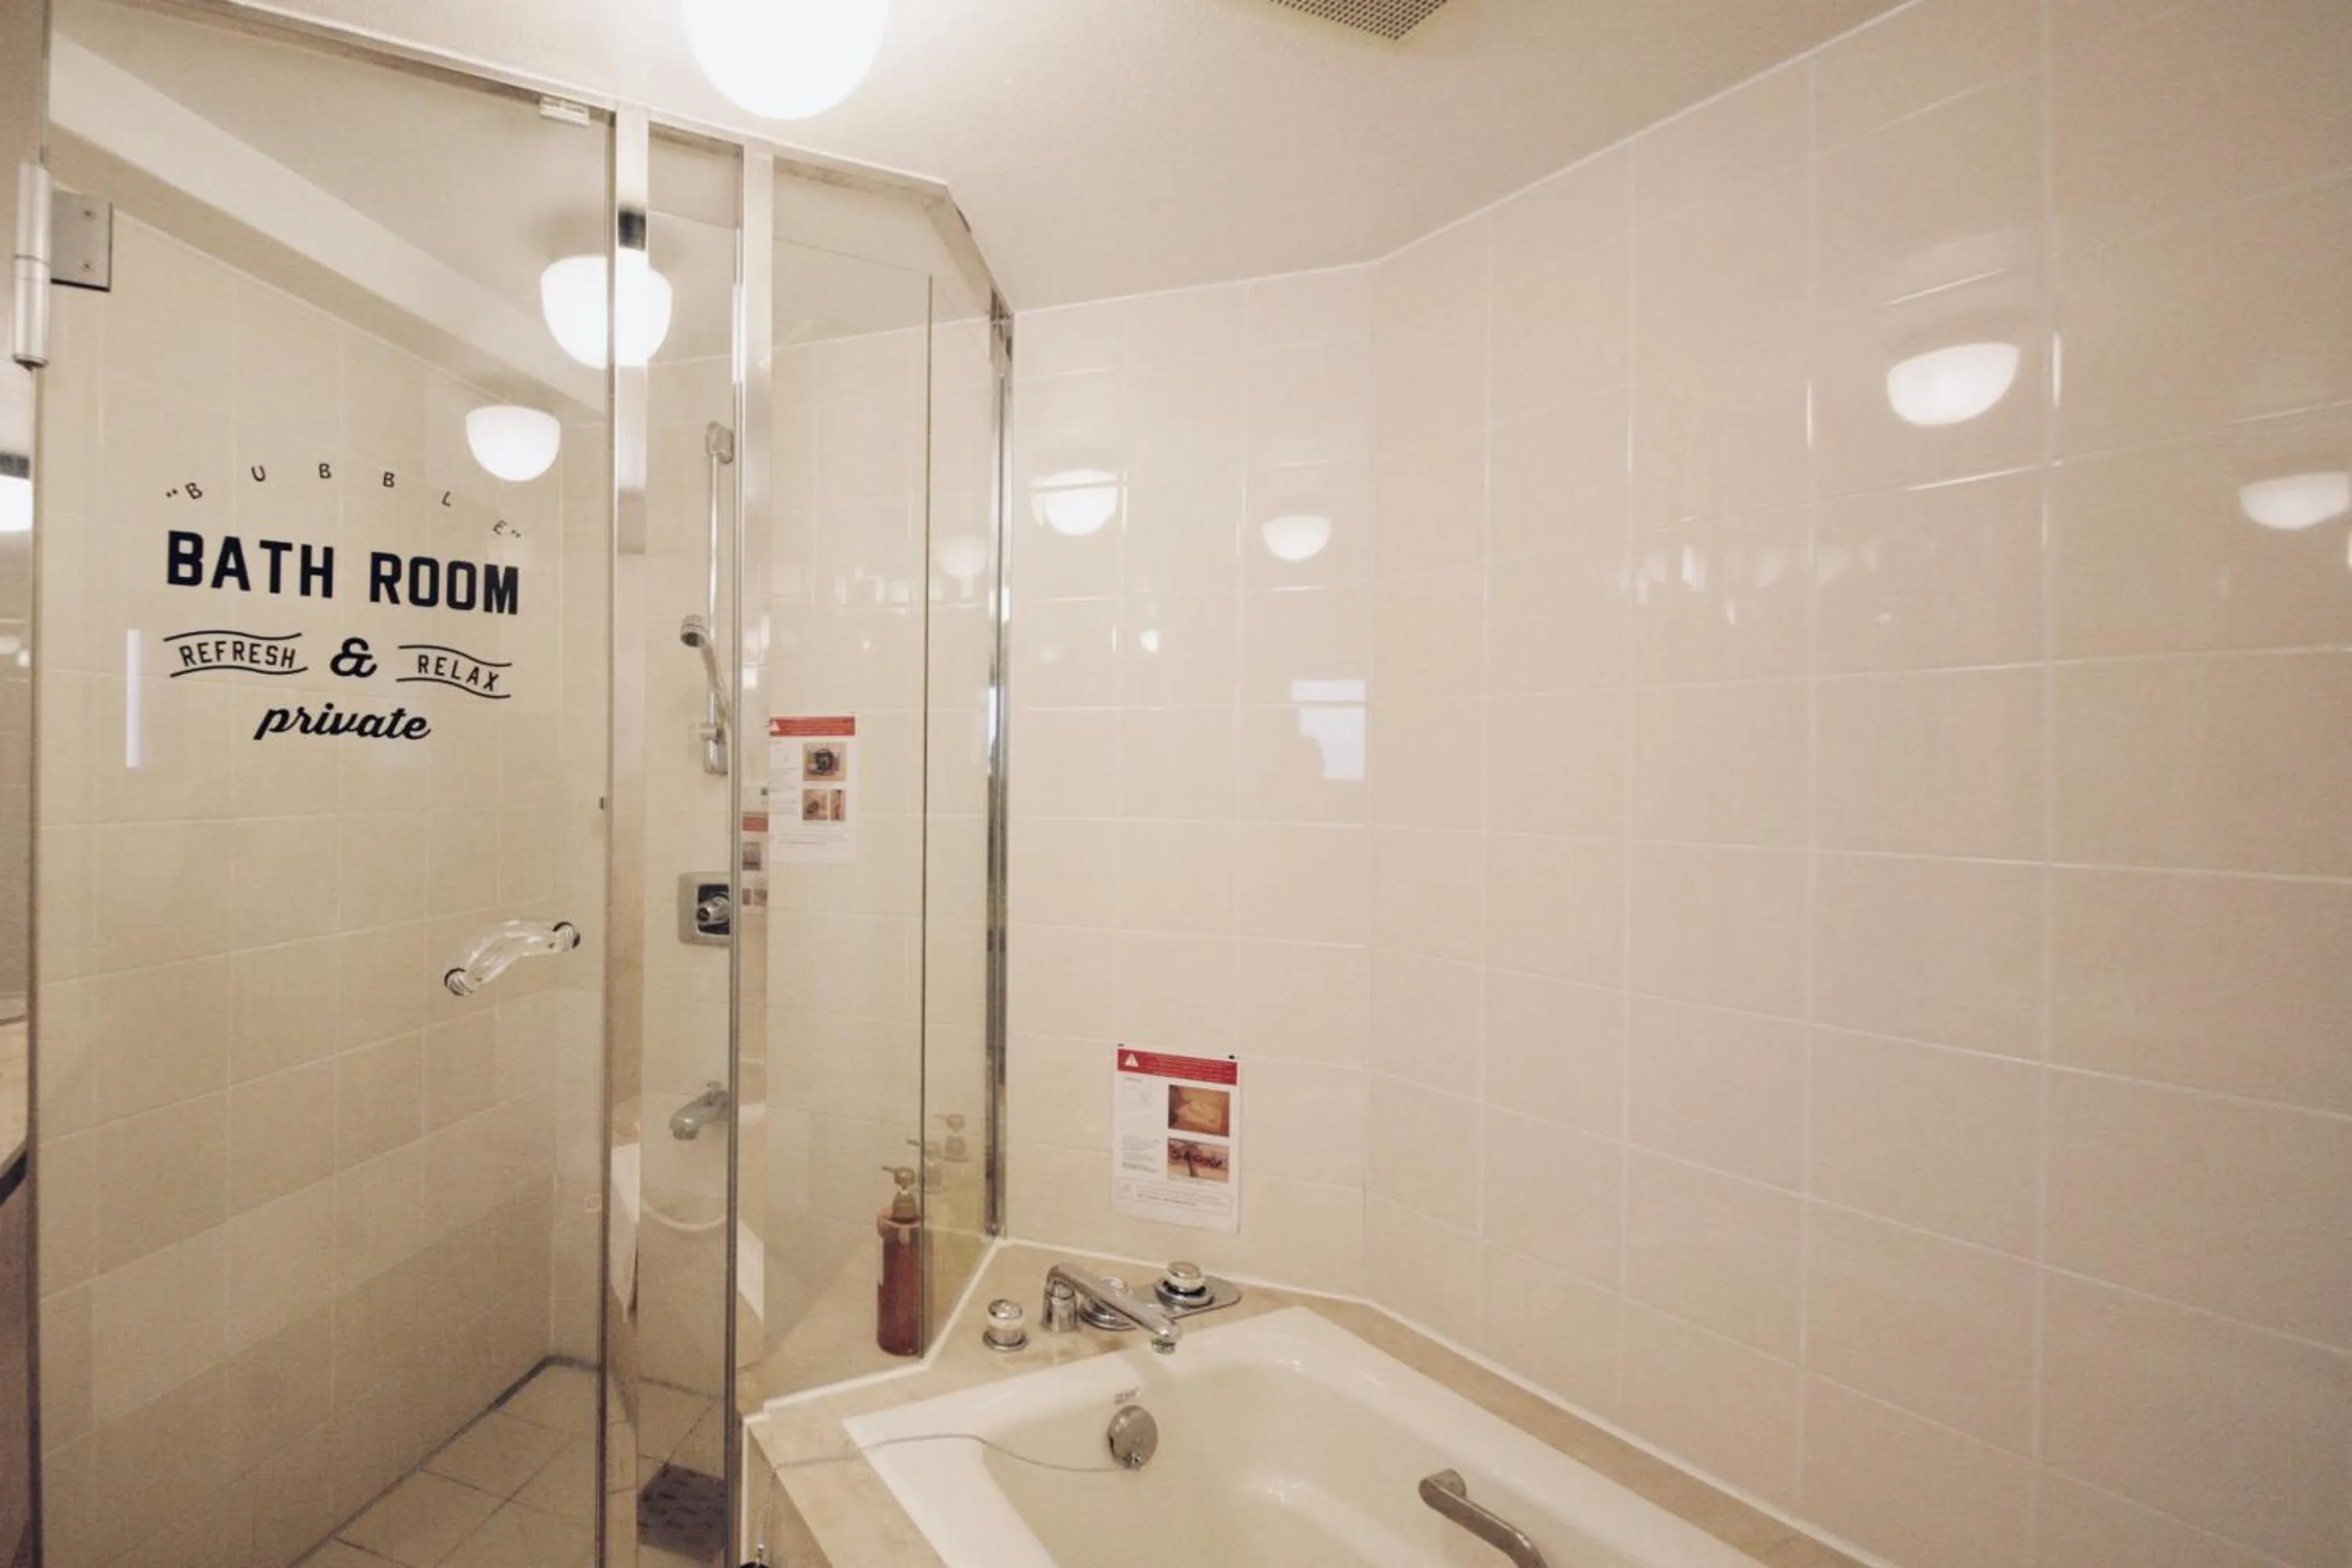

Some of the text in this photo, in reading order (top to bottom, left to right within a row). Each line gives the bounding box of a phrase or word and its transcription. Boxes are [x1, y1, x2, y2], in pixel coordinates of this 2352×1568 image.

[166, 529, 519, 615] BATH ROOM
[178, 636, 500, 693] REFRESH & RELAX
[252, 702, 432, 741] private
